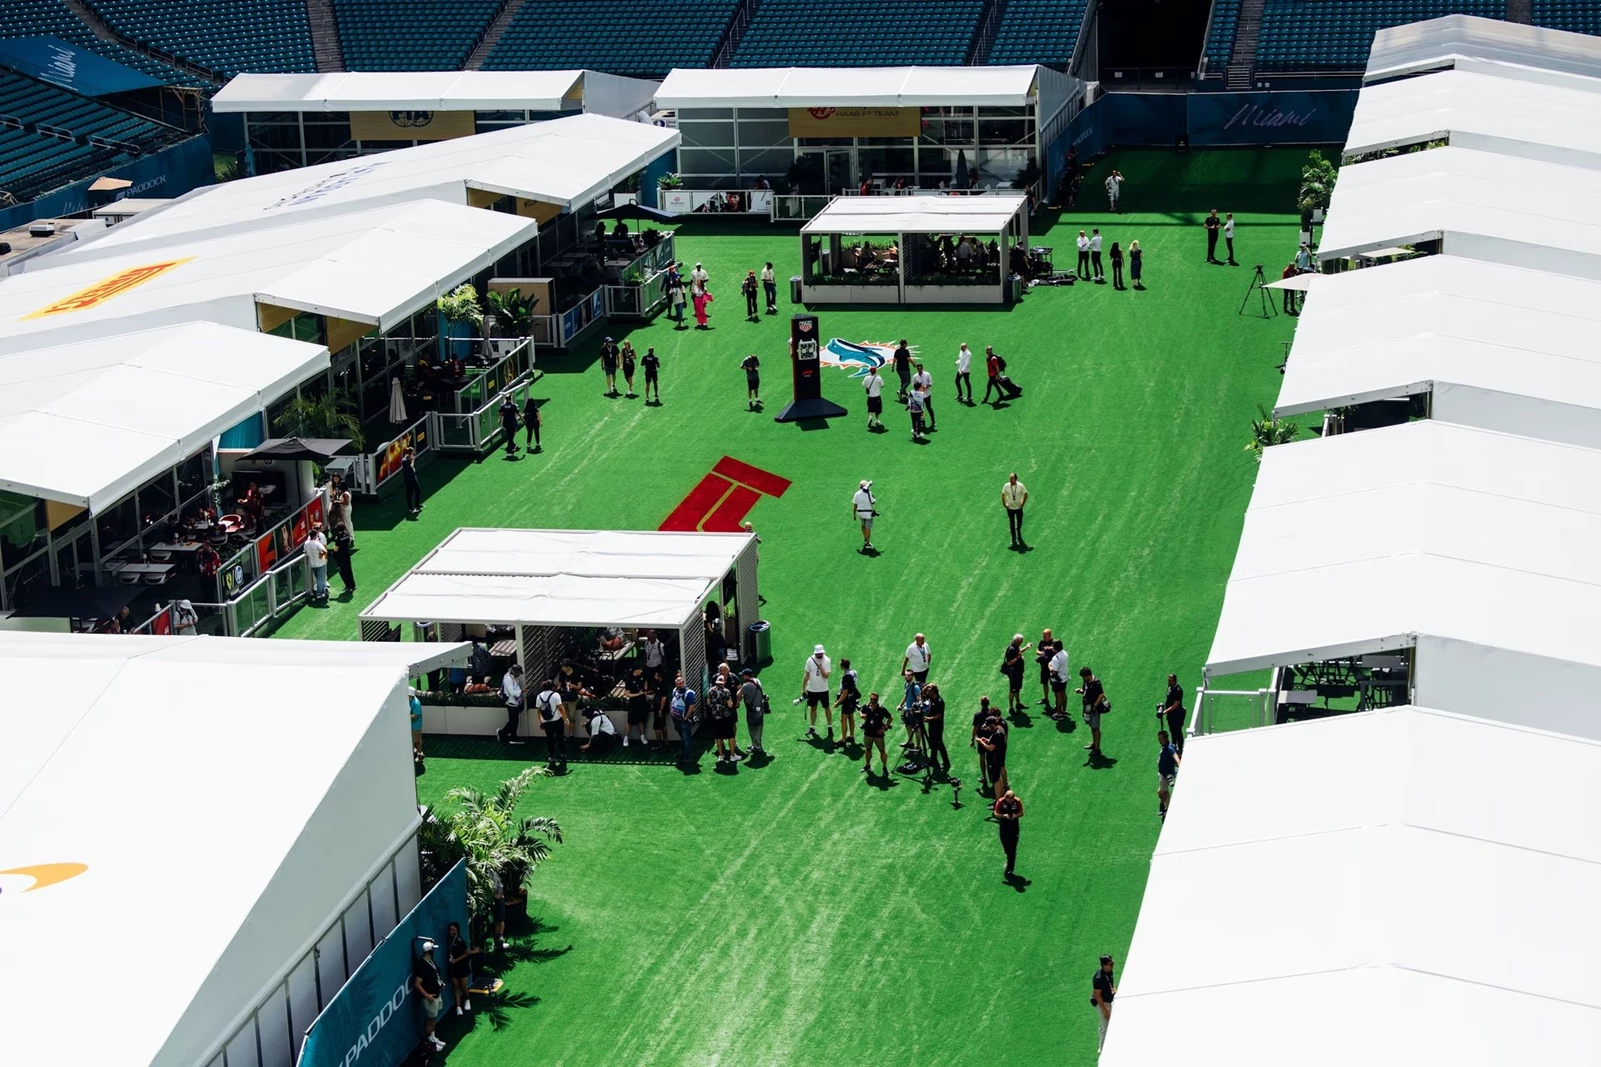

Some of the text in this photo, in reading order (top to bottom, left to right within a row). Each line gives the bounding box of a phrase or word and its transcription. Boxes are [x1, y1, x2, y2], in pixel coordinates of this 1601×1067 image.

[1224, 104, 1317, 129] Miami
[127, 174, 167, 197] PADDOCK
[345, 973, 414, 1067] PADDOC
